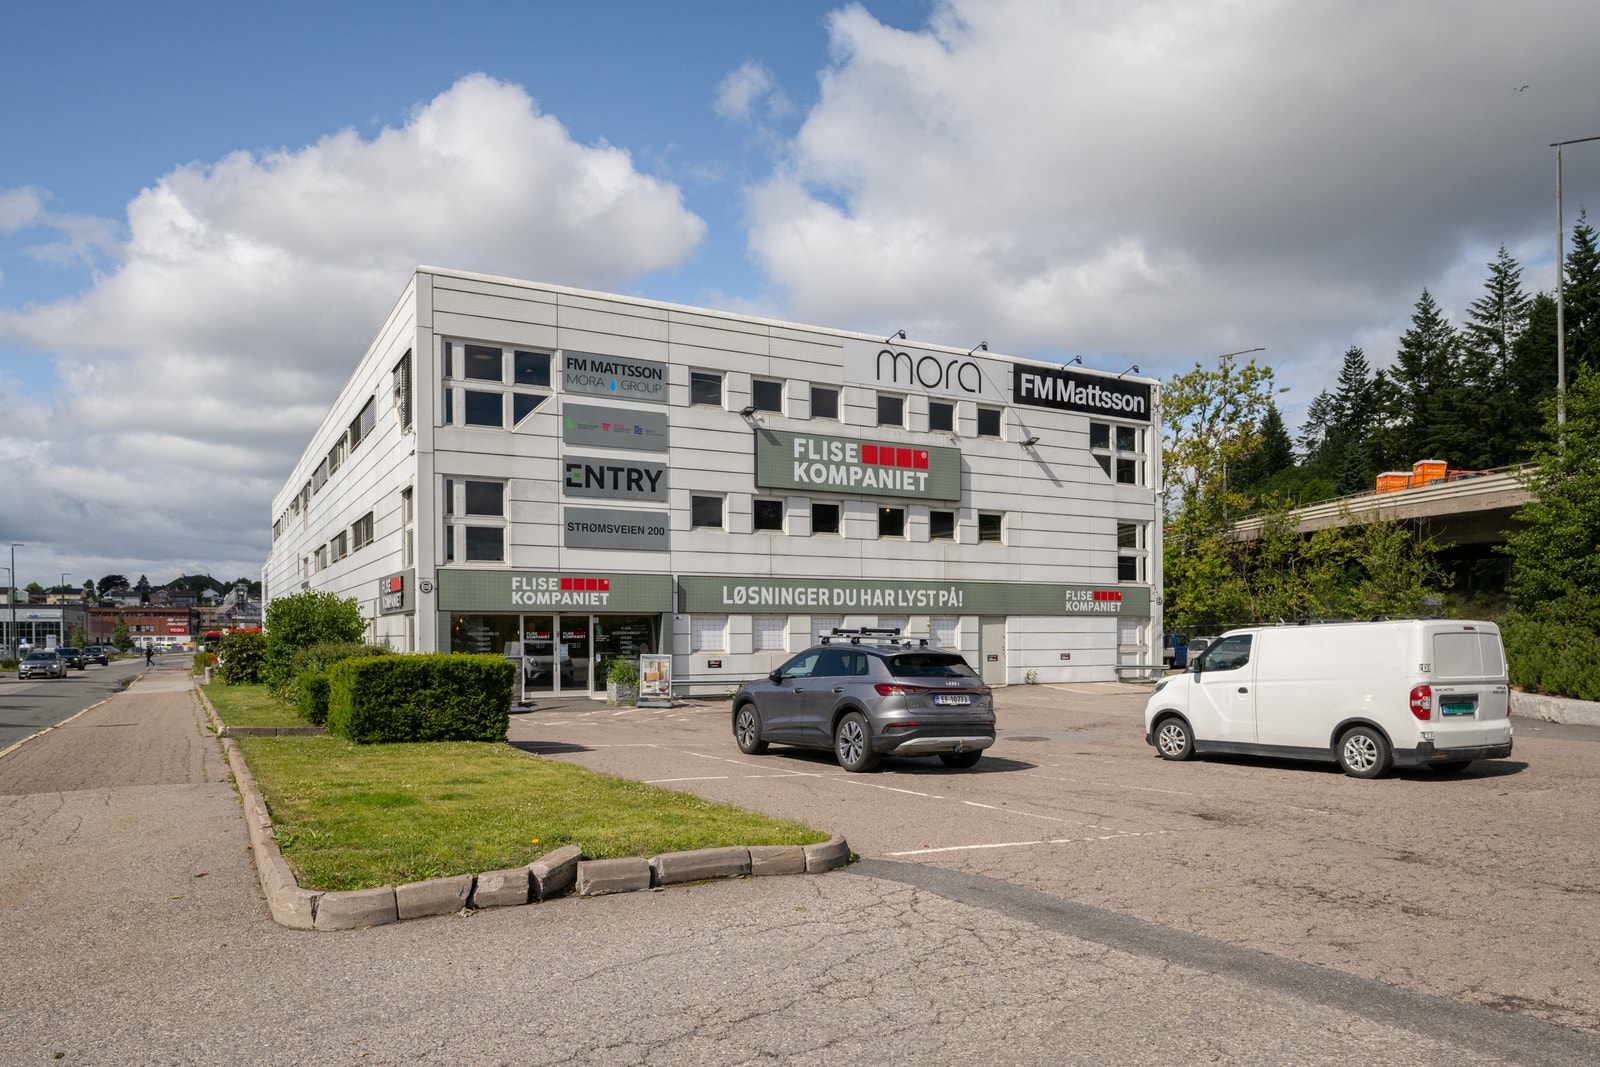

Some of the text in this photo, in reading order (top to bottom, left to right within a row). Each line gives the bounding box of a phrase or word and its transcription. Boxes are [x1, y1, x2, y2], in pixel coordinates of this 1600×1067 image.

[566, 357, 662, 380] FM MATTSSON
[876, 349, 982, 394] mora
[566, 373, 662, 393] MORA GROUP
[1021, 373, 1145, 413] FM Mattsson
[793, 437, 858, 463] FLISE
[566, 463, 663, 492] ENTRY
[793, 461, 929, 492] KOMPANIET
[567, 522, 665, 536] STRØMSVEIEN 200
[511, 577, 558, 591] FLISE
[511, 591, 610, 605] KOMPANIET
[722, 586, 963, 607] LØSNINGER DU HAR LYST PÅ!
[1065, 590, 1093, 601] FLISE
[1065, 601, 1122, 612] KOMPANIET
